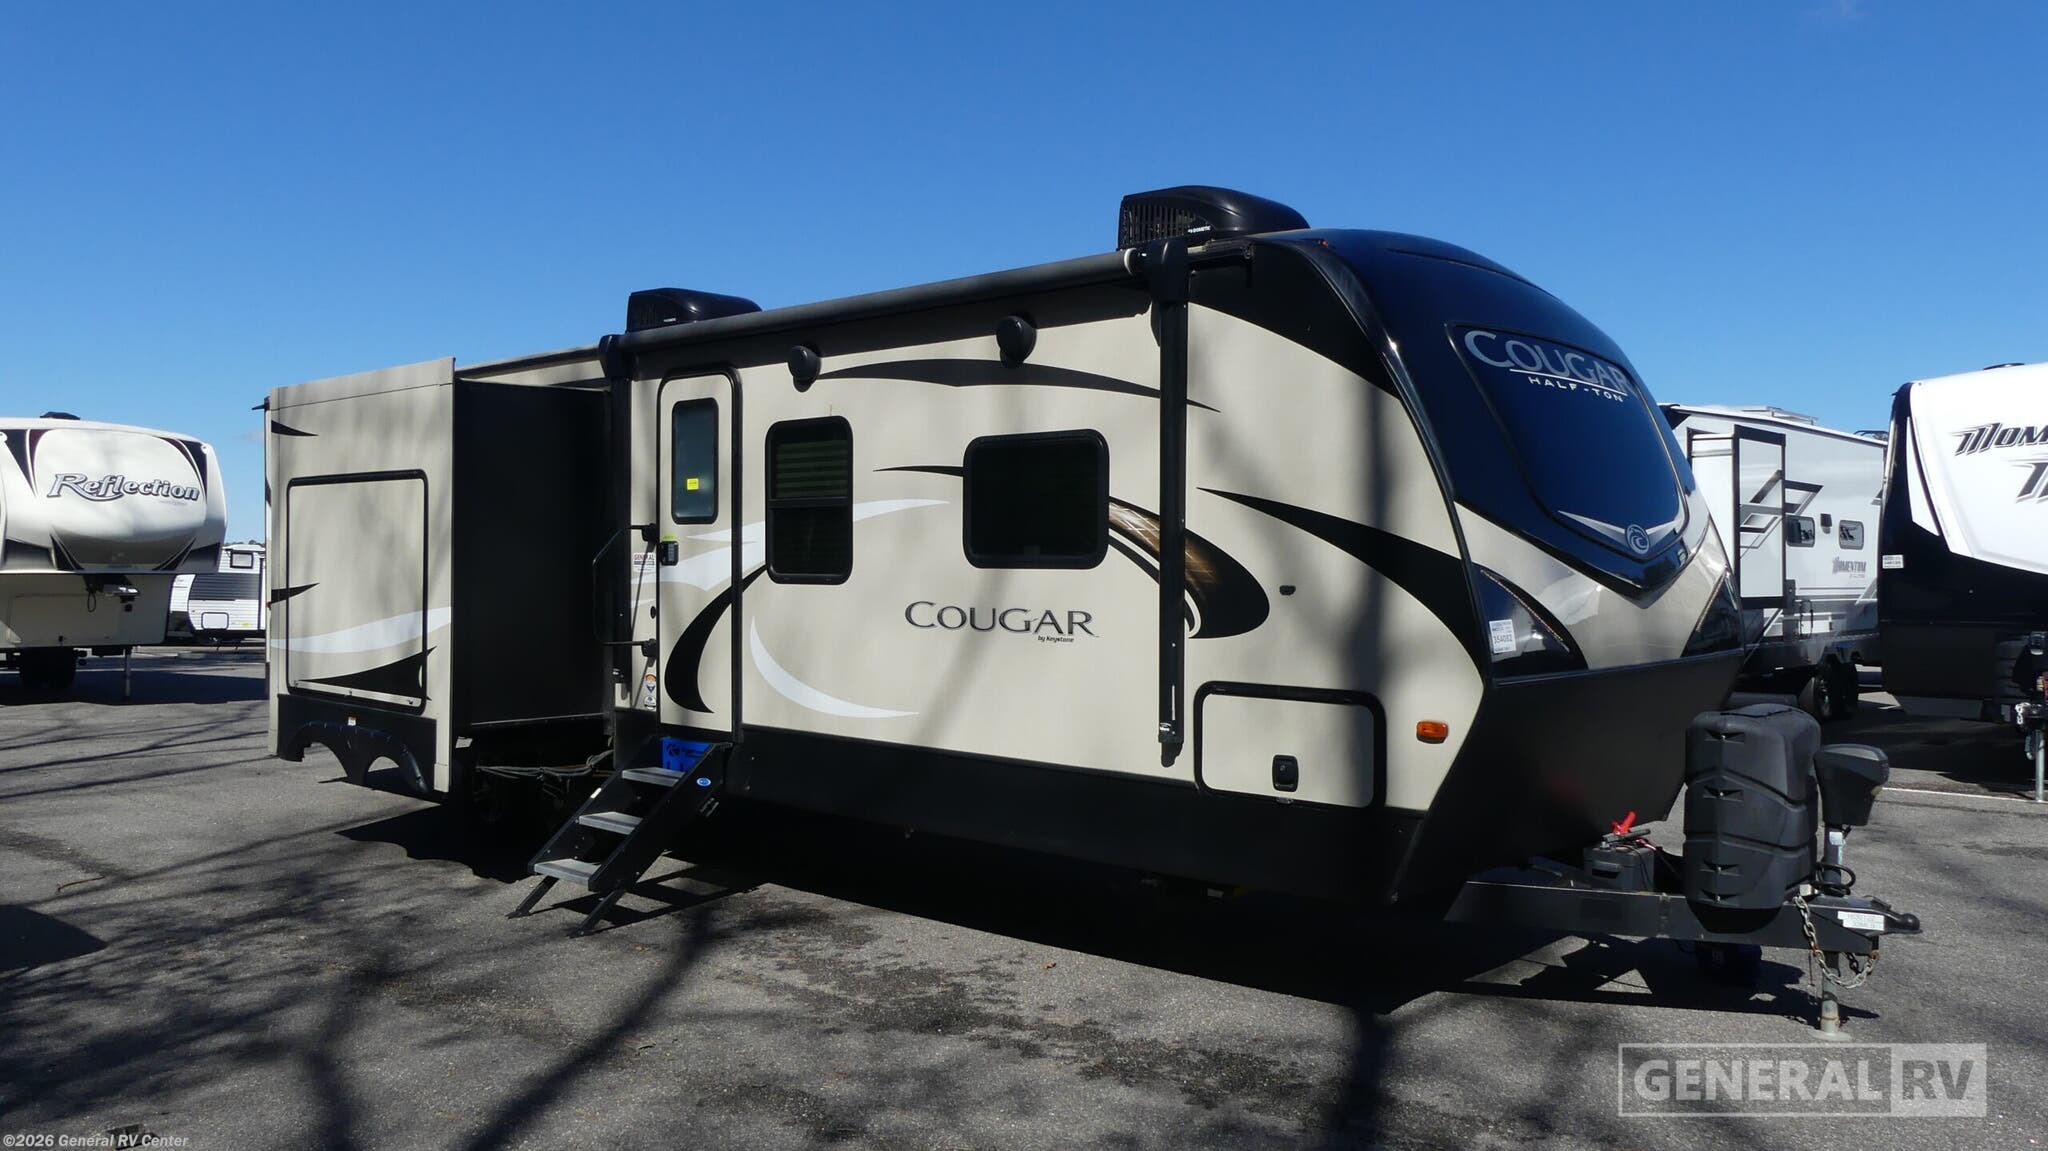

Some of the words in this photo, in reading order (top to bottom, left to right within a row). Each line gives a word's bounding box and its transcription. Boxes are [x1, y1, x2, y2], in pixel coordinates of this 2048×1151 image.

[1464, 330, 1637, 397] COUGAR
[1528, 376, 1624, 403] HALF-TON
[46, 473, 200, 502] Reflection
[904, 600, 1099, 638] COUGAR
[1038, 634, 1046, 643] by
[1046, 634, 1074, 643] Keystone
